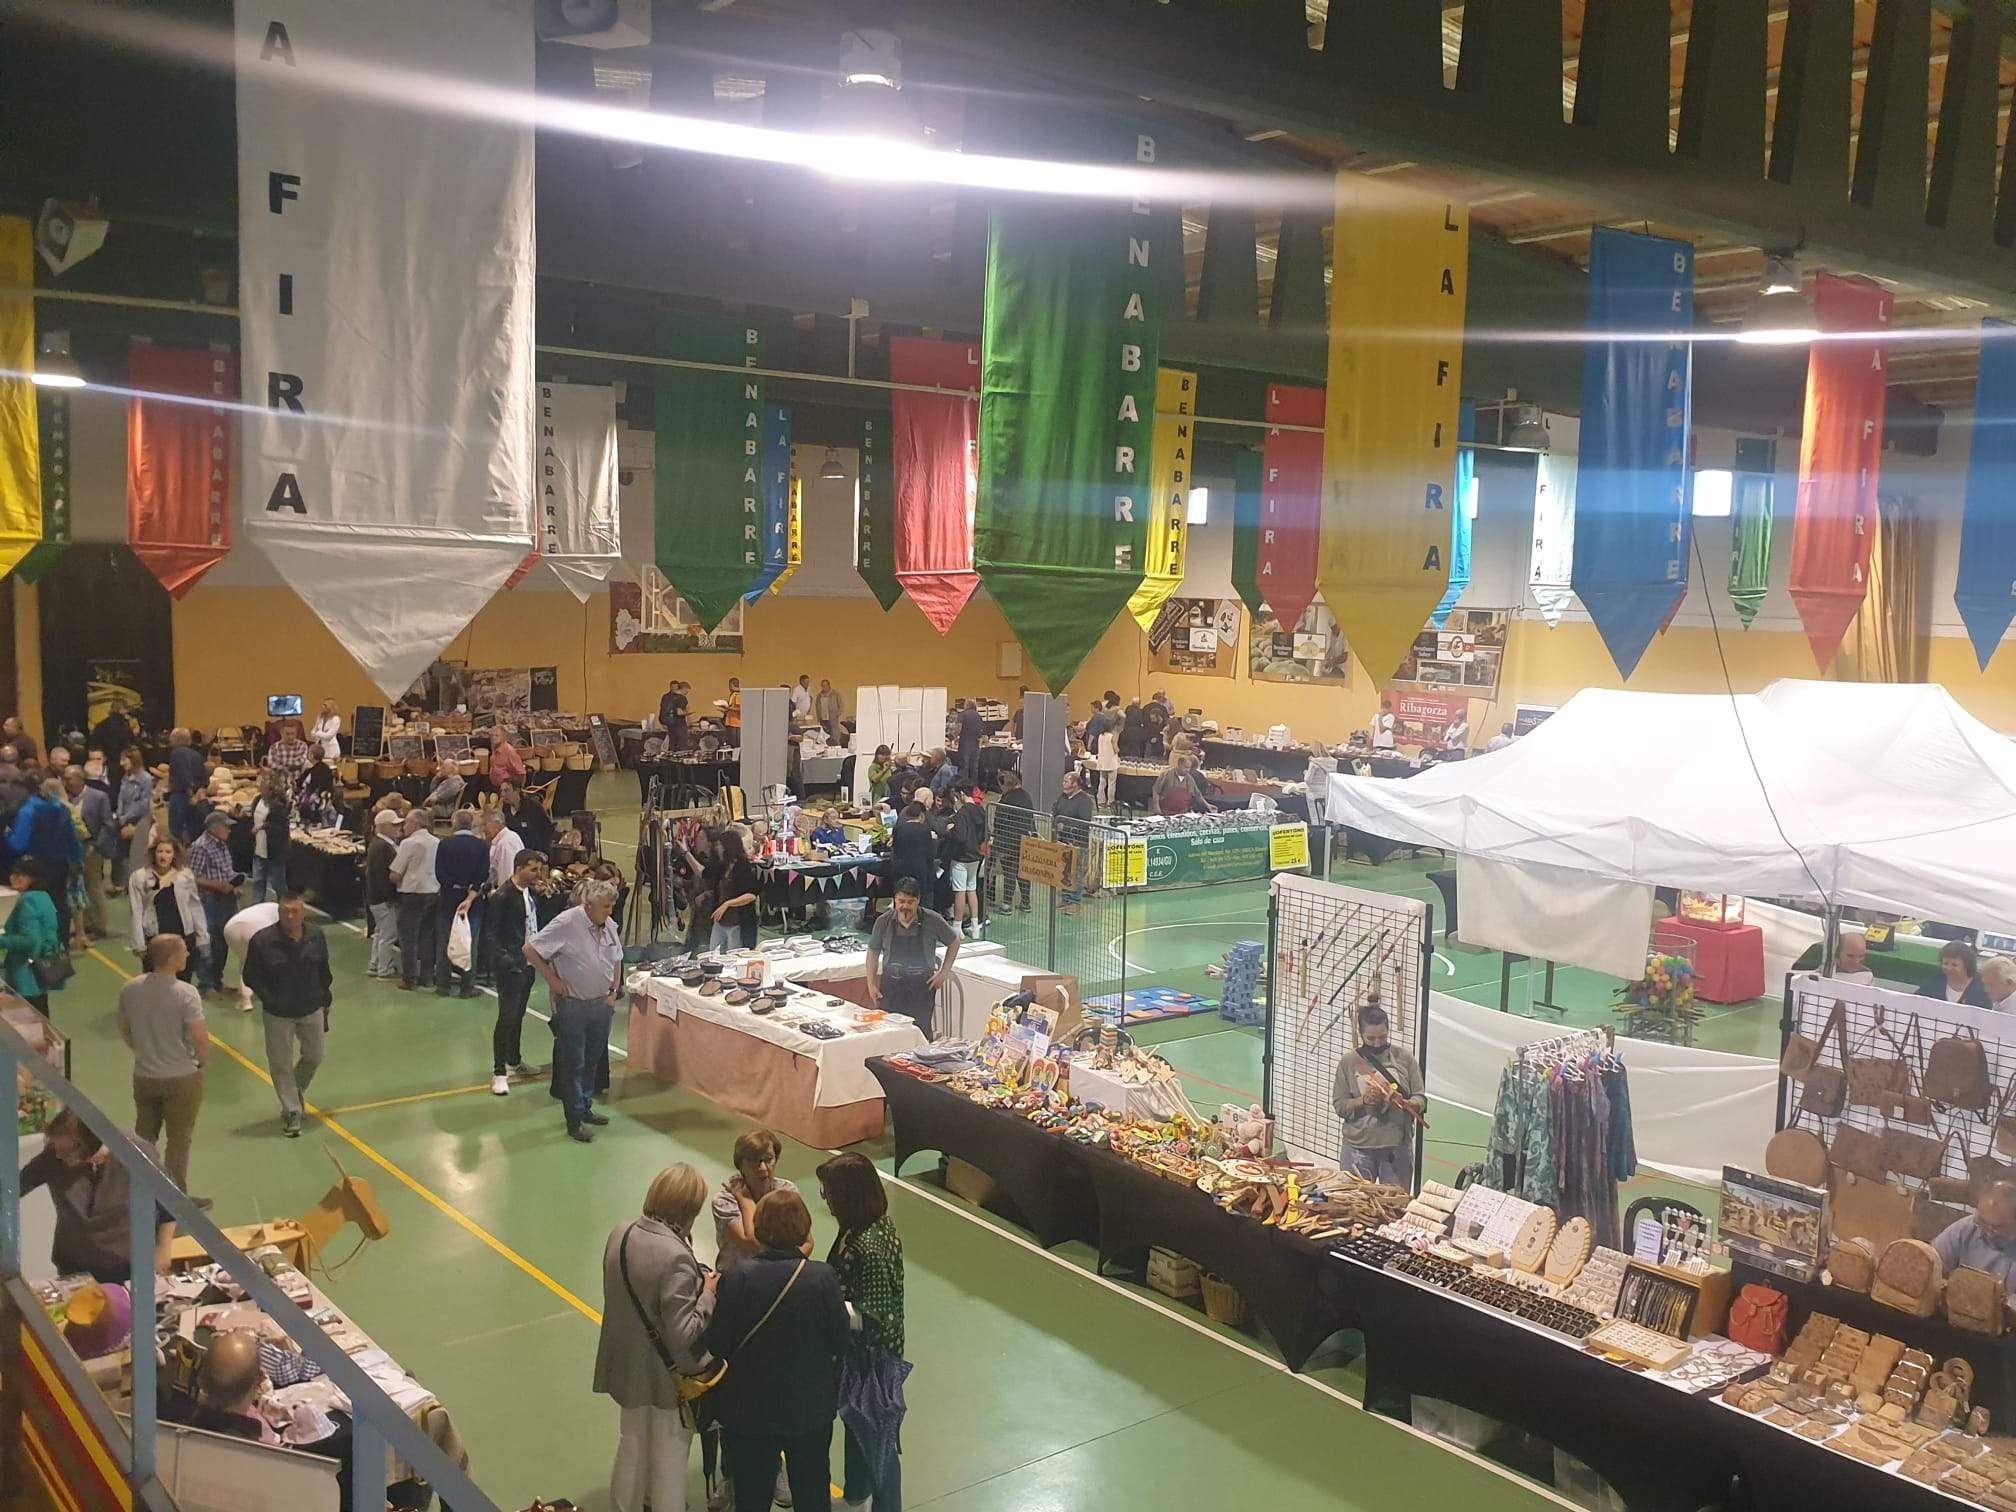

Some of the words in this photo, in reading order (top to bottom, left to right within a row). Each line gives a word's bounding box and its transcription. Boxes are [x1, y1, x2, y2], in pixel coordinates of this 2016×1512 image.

[1440, 204, 1459, 296] LA
[265, 171, 308, 515] FIRA
[1114, 134, 1156, 571] BENABARRE
[1870, 300, 1887, 371] LA
[209, 359, 225, 546] BENABARRE
[542, 387, 557, 554] BENABARRE
[744, 328, 758, 565] BENABARRE
[777, 409, 787, 448] LA
[1169, 378, 1190, 575] BENABARRE
[1269, 389, 1280, 436] LA
[1422, 360, 1449, 572] FIRA
[773, 472, 785, 559] FIRA
[790, 449, 798, 562] BENABARRE
[862, 420, 872, 568] BENABARRE
[1262, 469, 1278, 575] FIRA
[1534, 483, 1547, 579] FIRA
[1852, 420, 1875, 583] FIRA
[1400, 702, 1447, 717] Ribagorza
